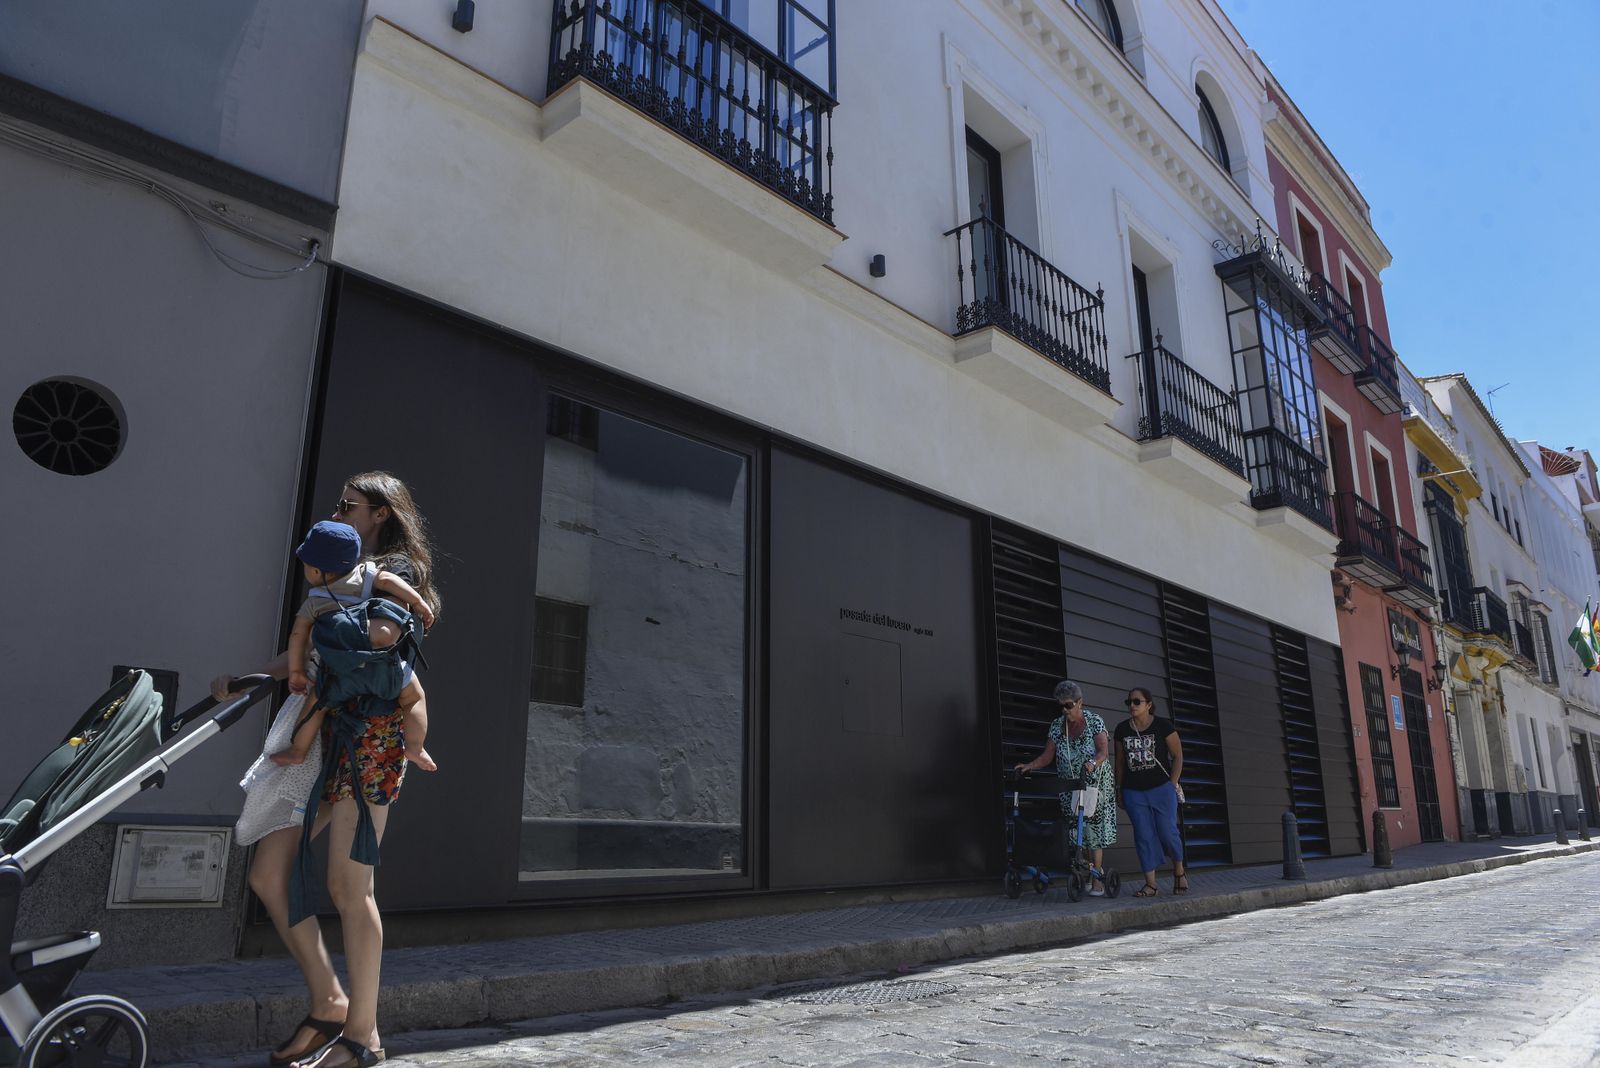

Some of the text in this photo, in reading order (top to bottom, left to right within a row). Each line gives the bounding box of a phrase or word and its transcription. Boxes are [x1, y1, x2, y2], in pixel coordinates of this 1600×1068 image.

[840, 608, 871, 623] posada
[873, 613, 885, 626] del
[886, 616, 911, 631] lucero
